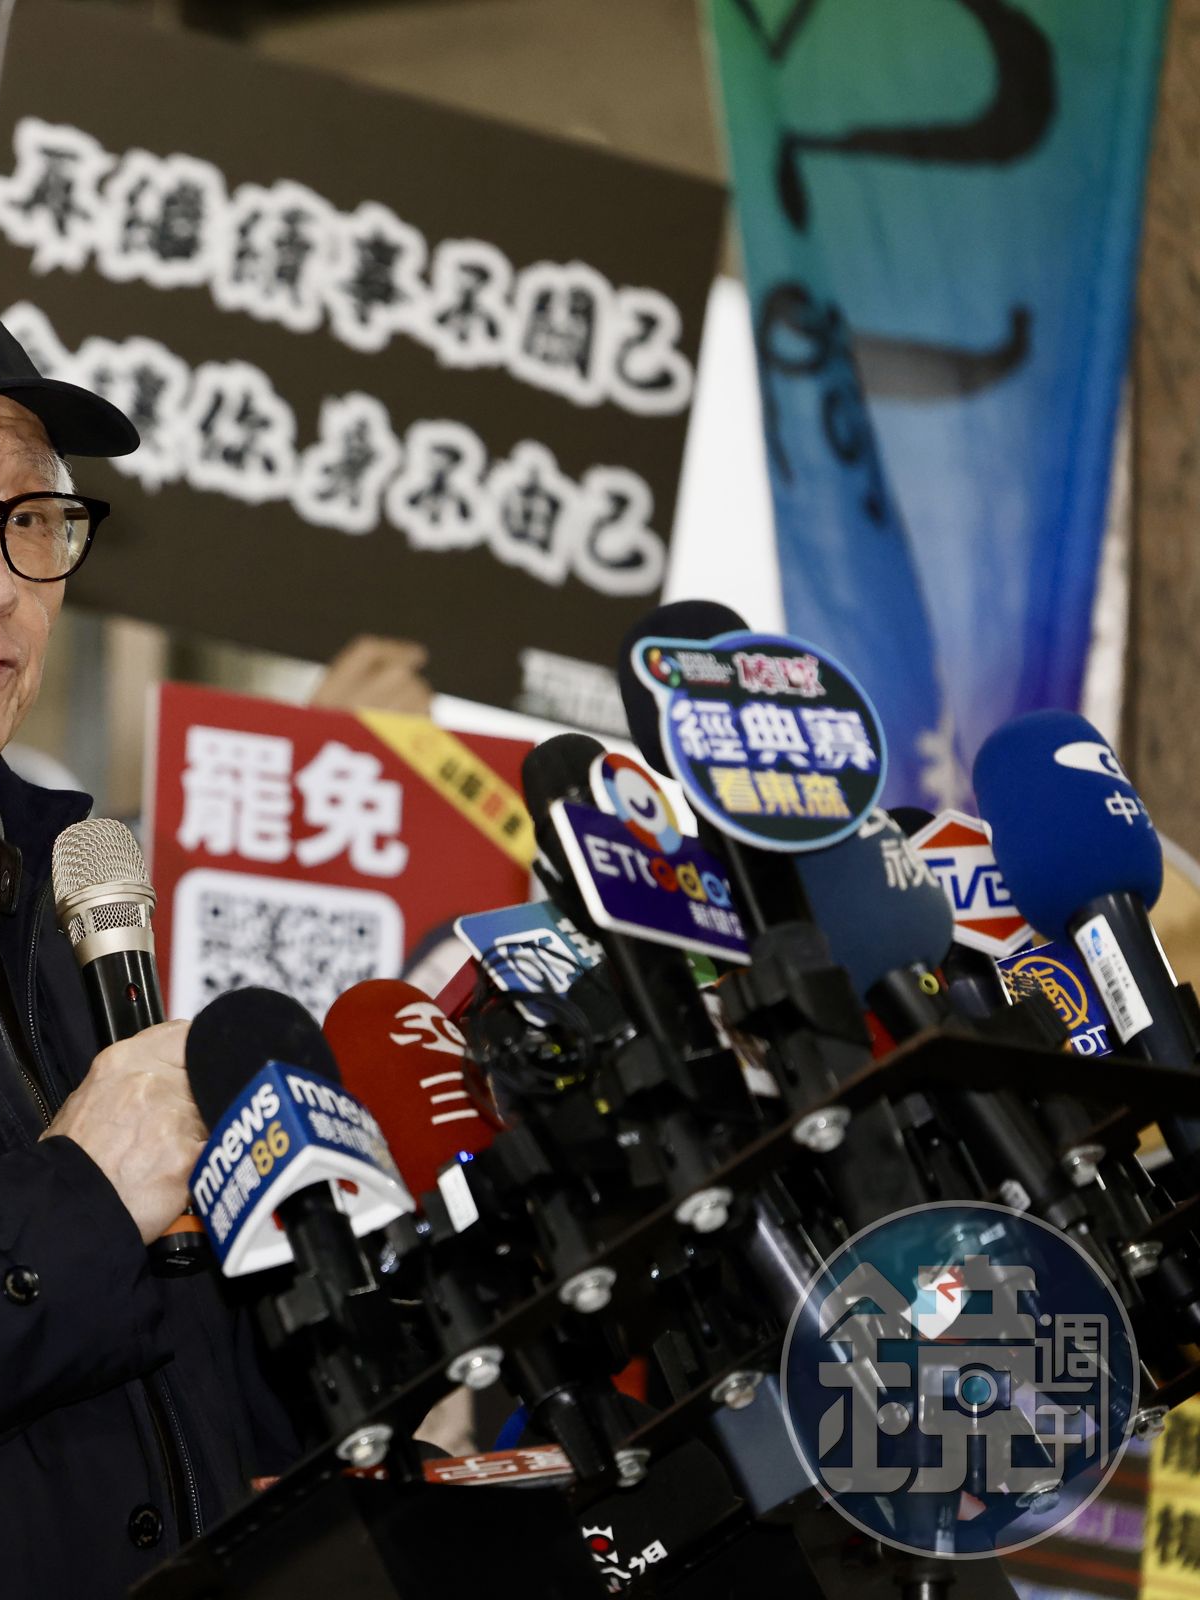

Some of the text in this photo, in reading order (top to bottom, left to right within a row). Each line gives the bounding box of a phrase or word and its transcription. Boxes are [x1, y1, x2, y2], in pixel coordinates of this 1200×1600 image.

[672, 699, 877, 771] 經典賽
[177, 725, 409, 878] 罷免
[583, 833, 732, 908] ETtoda
[193, 1082, 281, 1216] mnews
